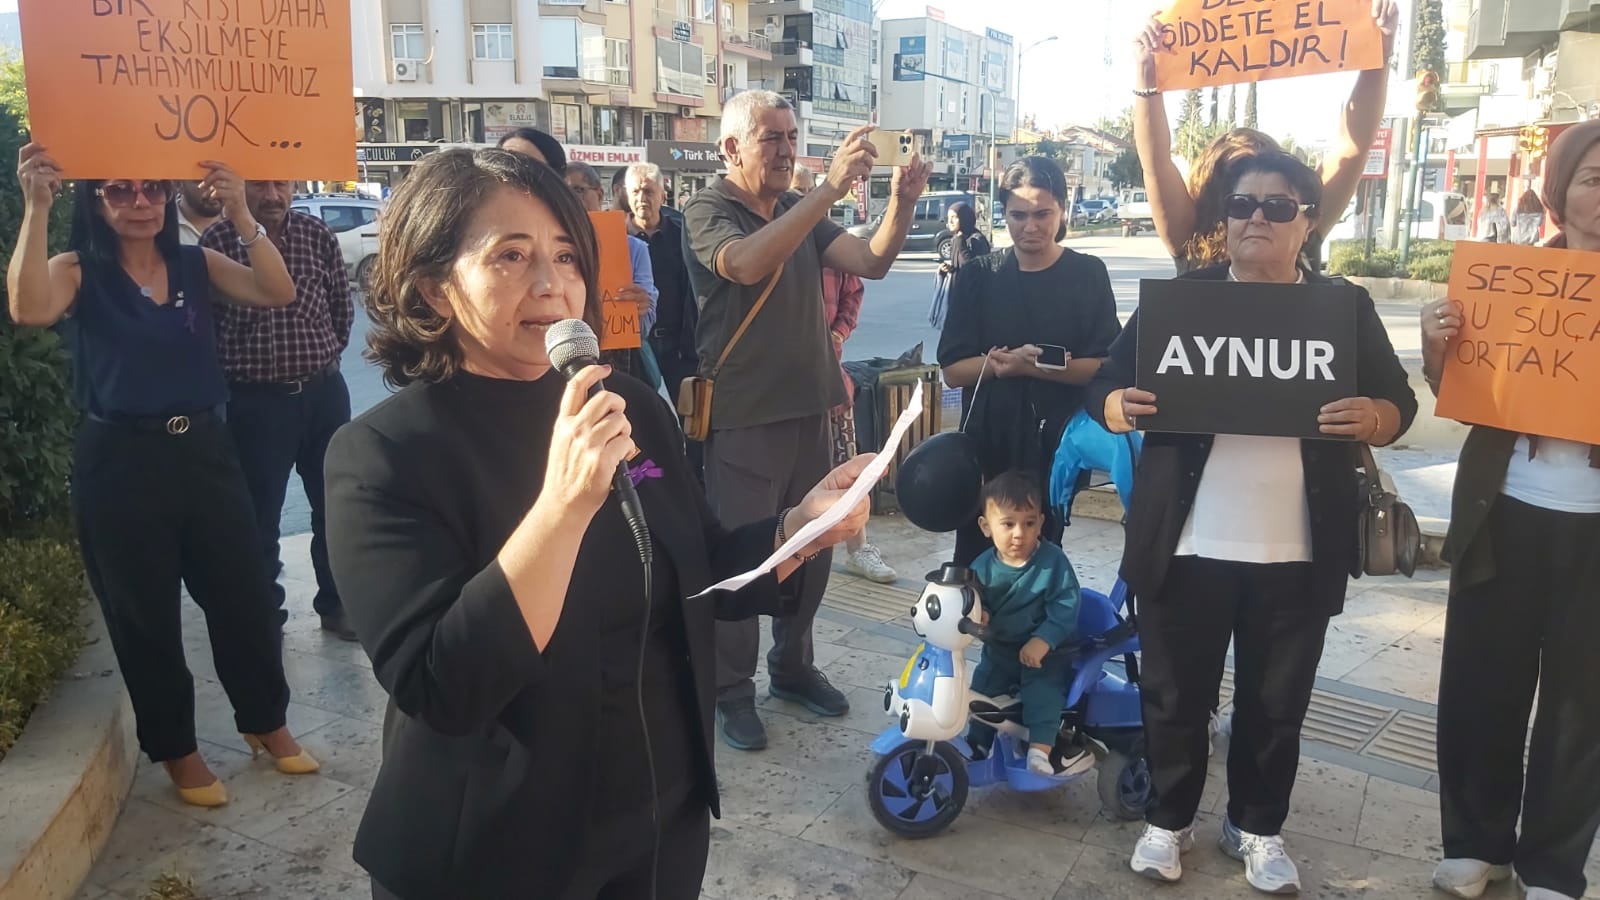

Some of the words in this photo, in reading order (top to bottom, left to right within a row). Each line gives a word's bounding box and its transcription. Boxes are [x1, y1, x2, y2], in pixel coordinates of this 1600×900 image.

[260, 0, 328, 29] DAHA
[1294, 1, 1341, 30] EL
[366, 148, 396, 161] CULUK
[569, 148, 605, 162] ÖZMEN
[607, 152, 640, 163] EMLAK
[683, 149, 703, 161] Türk
[1155, 335, 1336, 381] AYNUR
[1456, 340, 1579, 382] ORTAK
